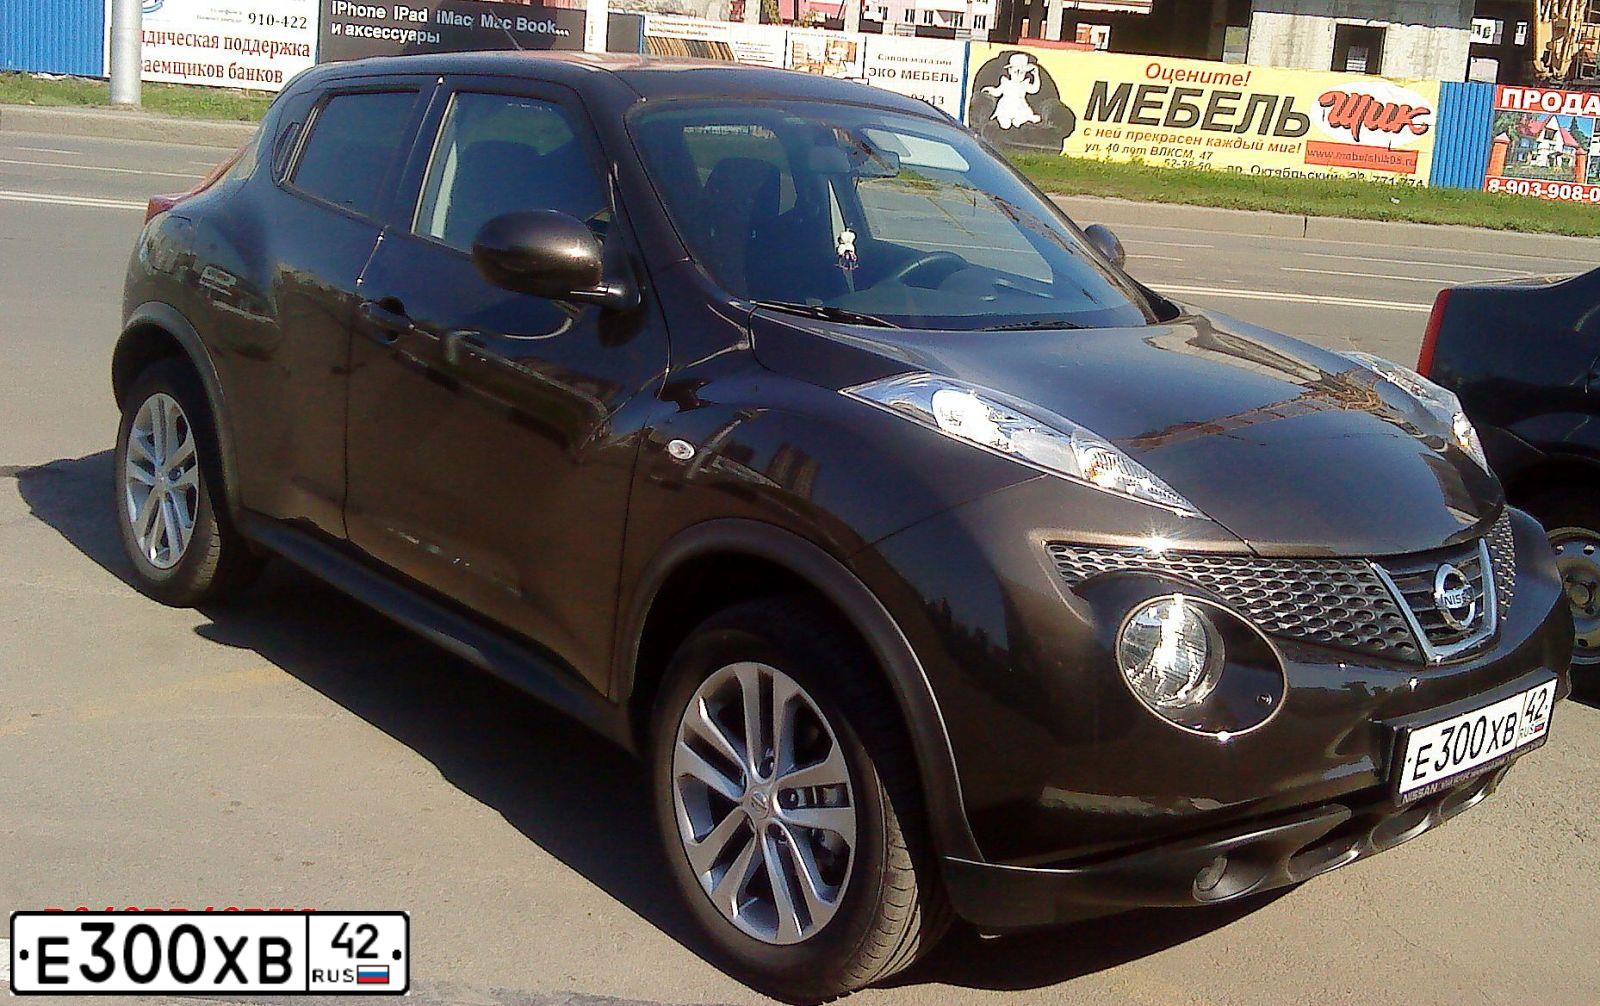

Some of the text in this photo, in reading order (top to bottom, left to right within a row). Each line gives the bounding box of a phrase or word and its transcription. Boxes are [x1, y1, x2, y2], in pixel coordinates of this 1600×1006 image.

[248, 12, 307, 30] 910-422
[436, 9, 472, 27] iMac
[480, 14, 512, 30] Mac
[516, 17, 570, 37] Book...
[331, 22, 440, 44] и аксессуары
[224, 36, 310, 59] поддержка
[228, 62, 283, 83] банков
[868, 67, 959, 83] ЭКО МЕБЕЛЬ
[1145, 62, 1252, 87] Оцените!
[1083, 80, 1310, 138] МЕБЕЛЬ
[1083, 127, 1302, 154] с ней прекрасен каждый миг!
[1199, 151, 1214, 161] 47
[1525, 688, 1548, 723] 42
